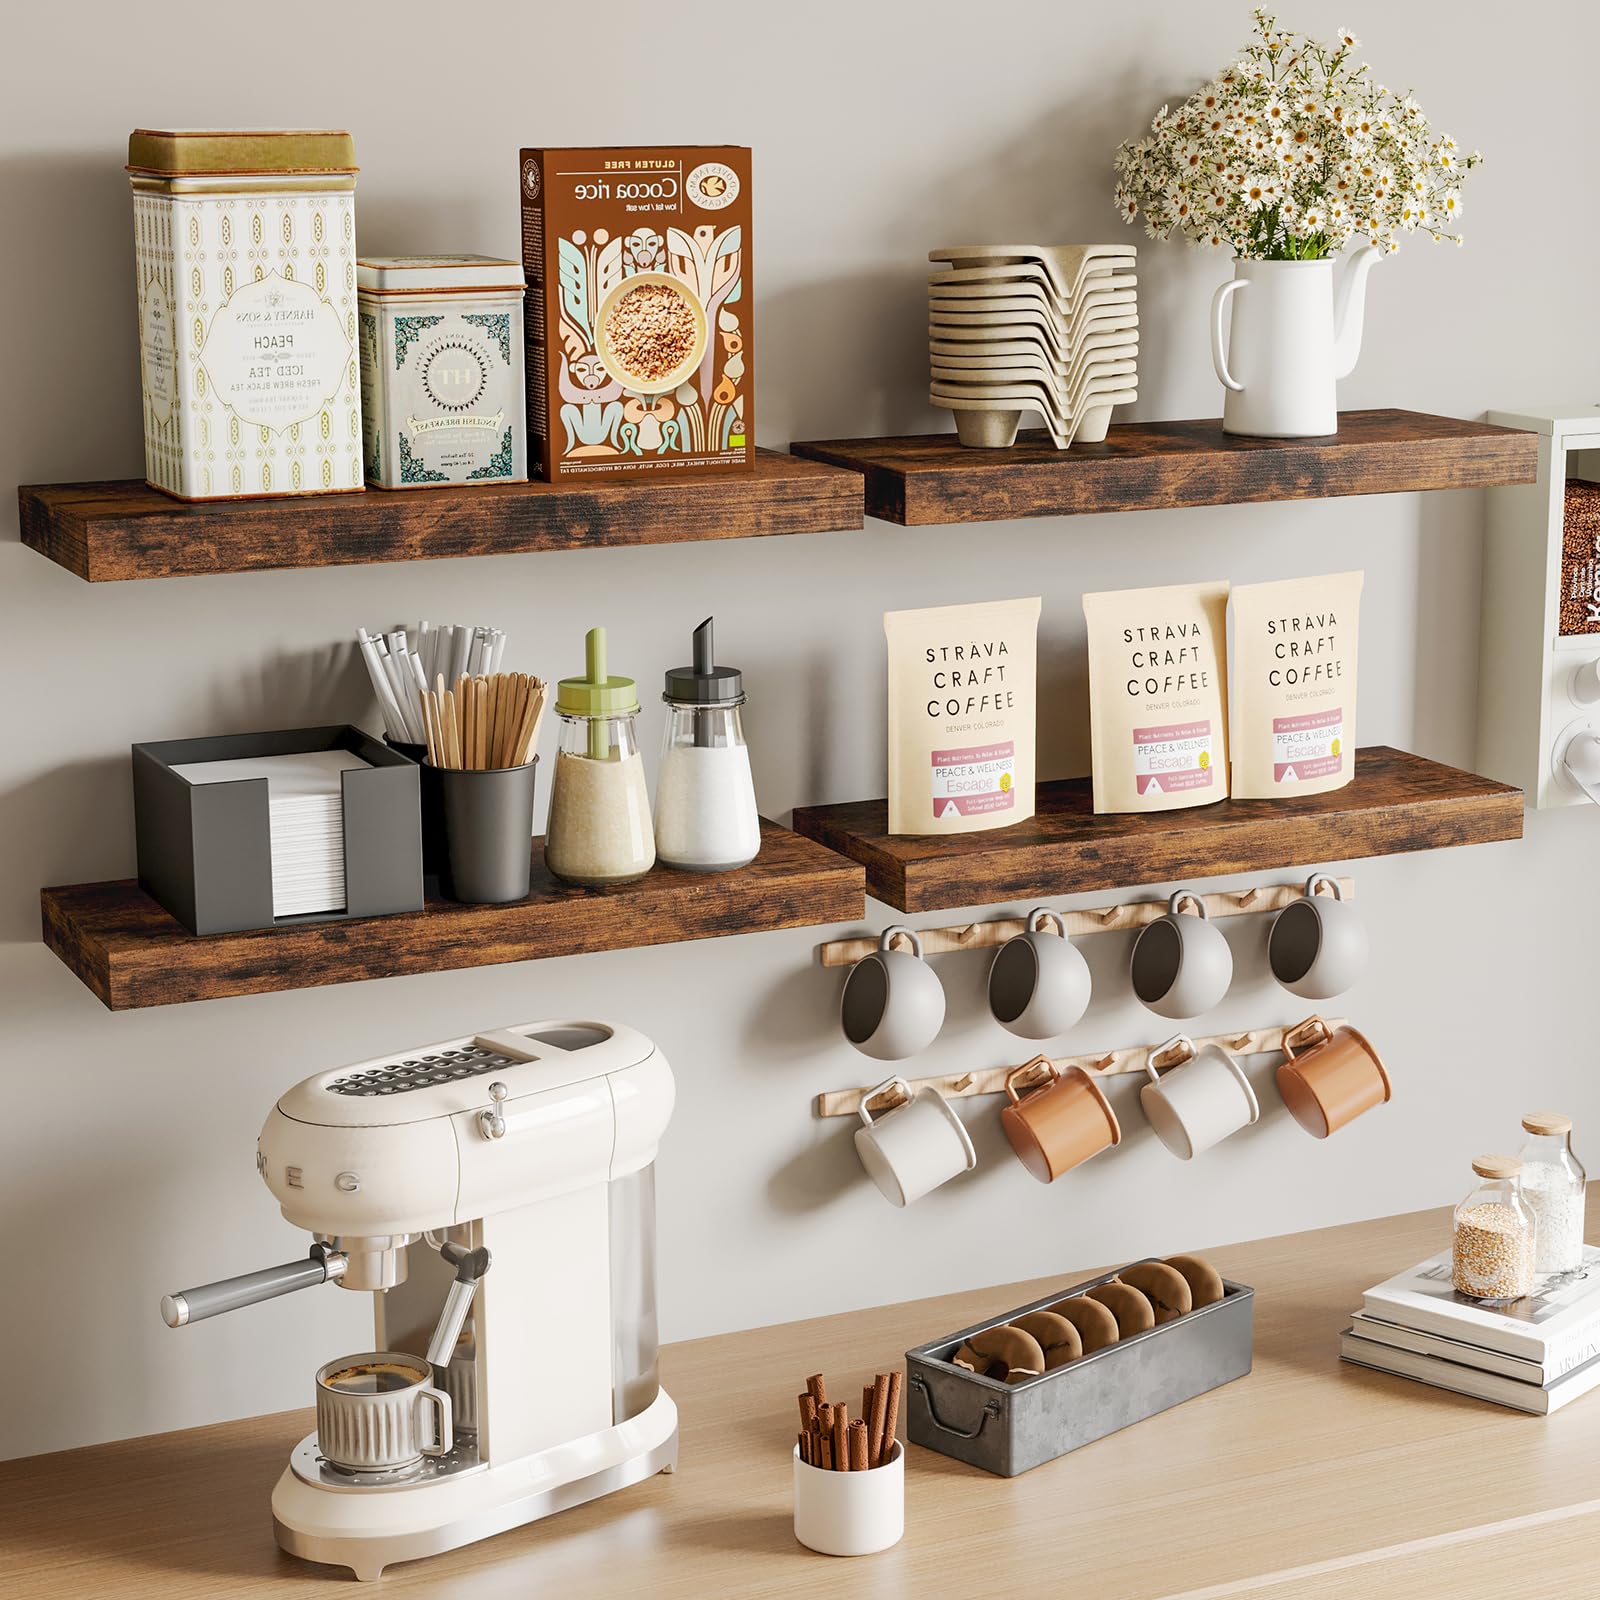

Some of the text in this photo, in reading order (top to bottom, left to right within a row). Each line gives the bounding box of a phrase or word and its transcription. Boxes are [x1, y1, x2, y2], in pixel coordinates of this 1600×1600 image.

[1275, 636, 1334, 659] CRAFT
[1132, 646, 1199, 668] CRAFT
[934, 666, 1005, 688] CRAFT
[1269, 661, 1342, 686] COFFEE
[1127, 672, 1208, 696] COFFEE
[927, 692, 1014, 717] COFFEE
[1146, 702, 1170, 711] DENVER
[946, 720, 1004, 732] DENVER COLORADO
[1277, 733, 1304, 744] PEACE
[1305, 732, 1310, 740] &
[1138, 744, 1167, 754] PEACE
[1169, 744, 1175, 752] &
[1287, 744, 1326, 758] Escape
[936, 760, 1012, 778] PEACE & WELLNESS
[1149, 756, 1192, 770] Escape
[946, 778, 992, 793] Escape
